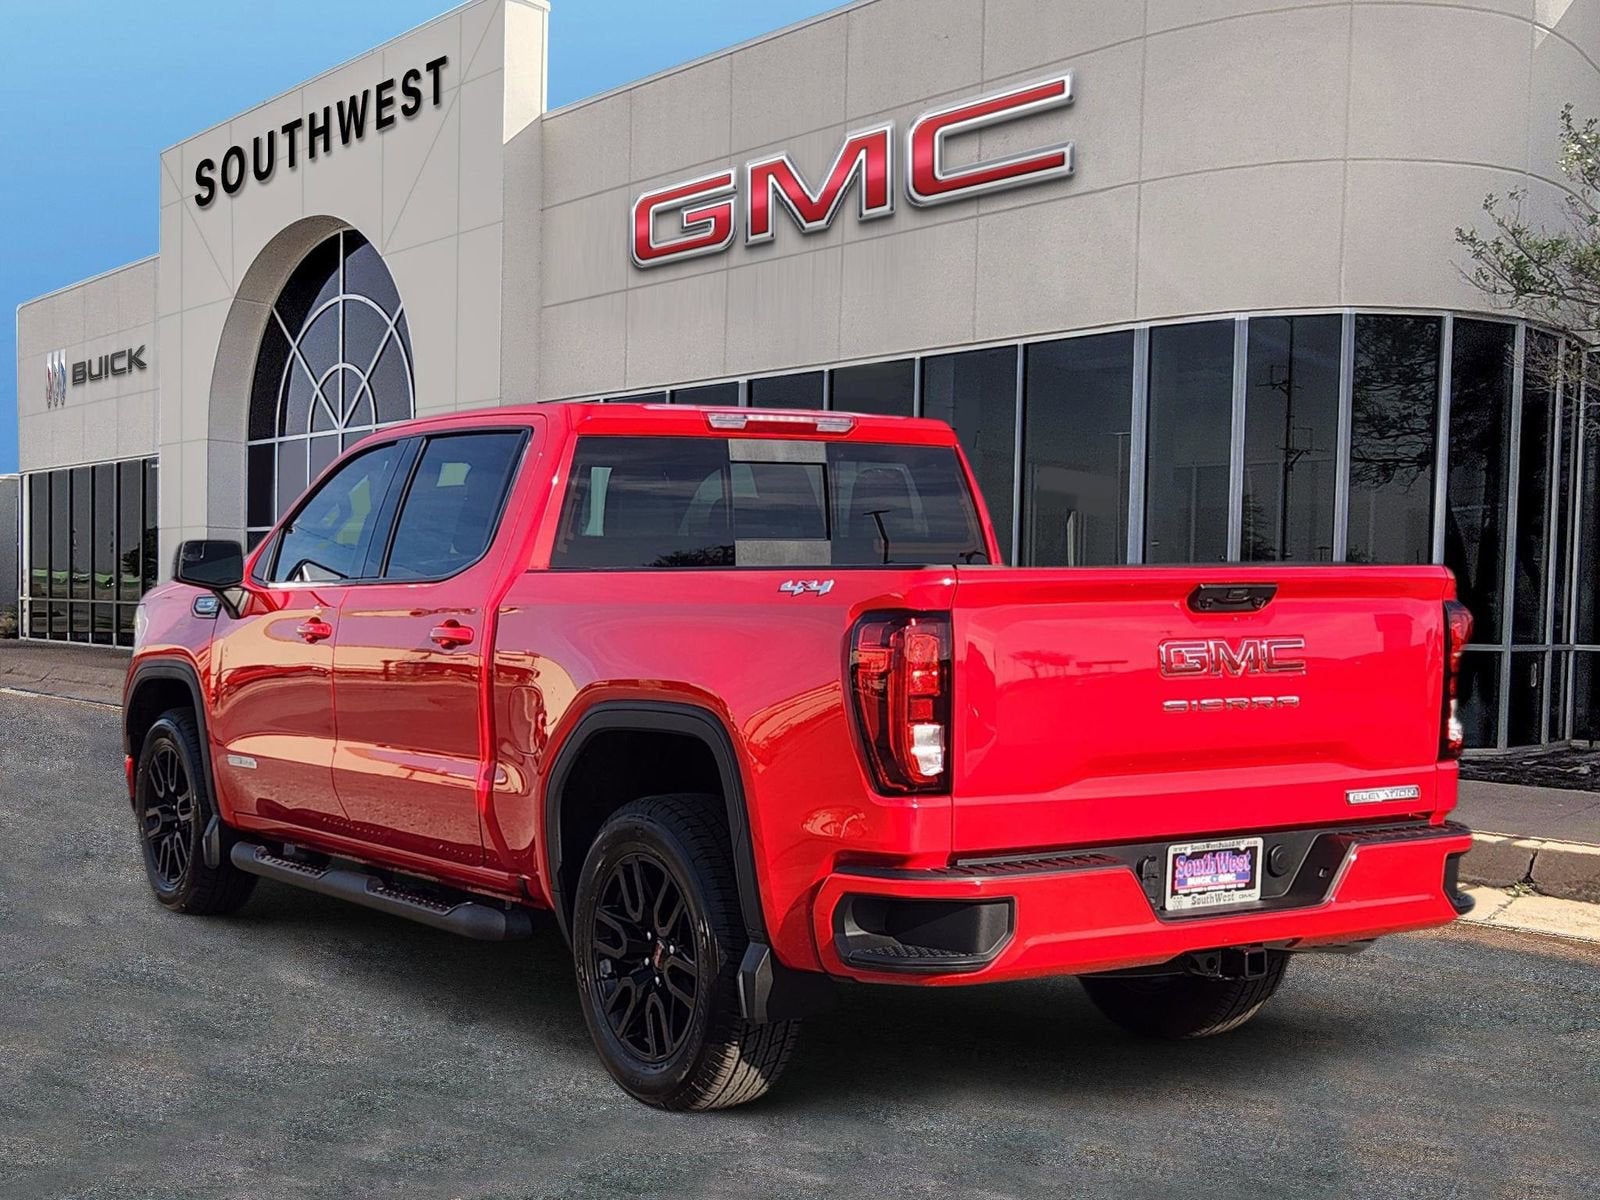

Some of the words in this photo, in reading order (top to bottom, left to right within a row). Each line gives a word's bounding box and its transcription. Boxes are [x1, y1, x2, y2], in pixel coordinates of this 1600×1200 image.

[195, 55, 447, 208] SOUTHWEST
[630, 69, 1076, 269] GMC
[72, 344, 147, 386] BUICK
[1159, 635, 1306, 678] GMC
[1162, 695, 1300, 712] SIERRA
[1351, 785, 1418, 803] ELEVATION
